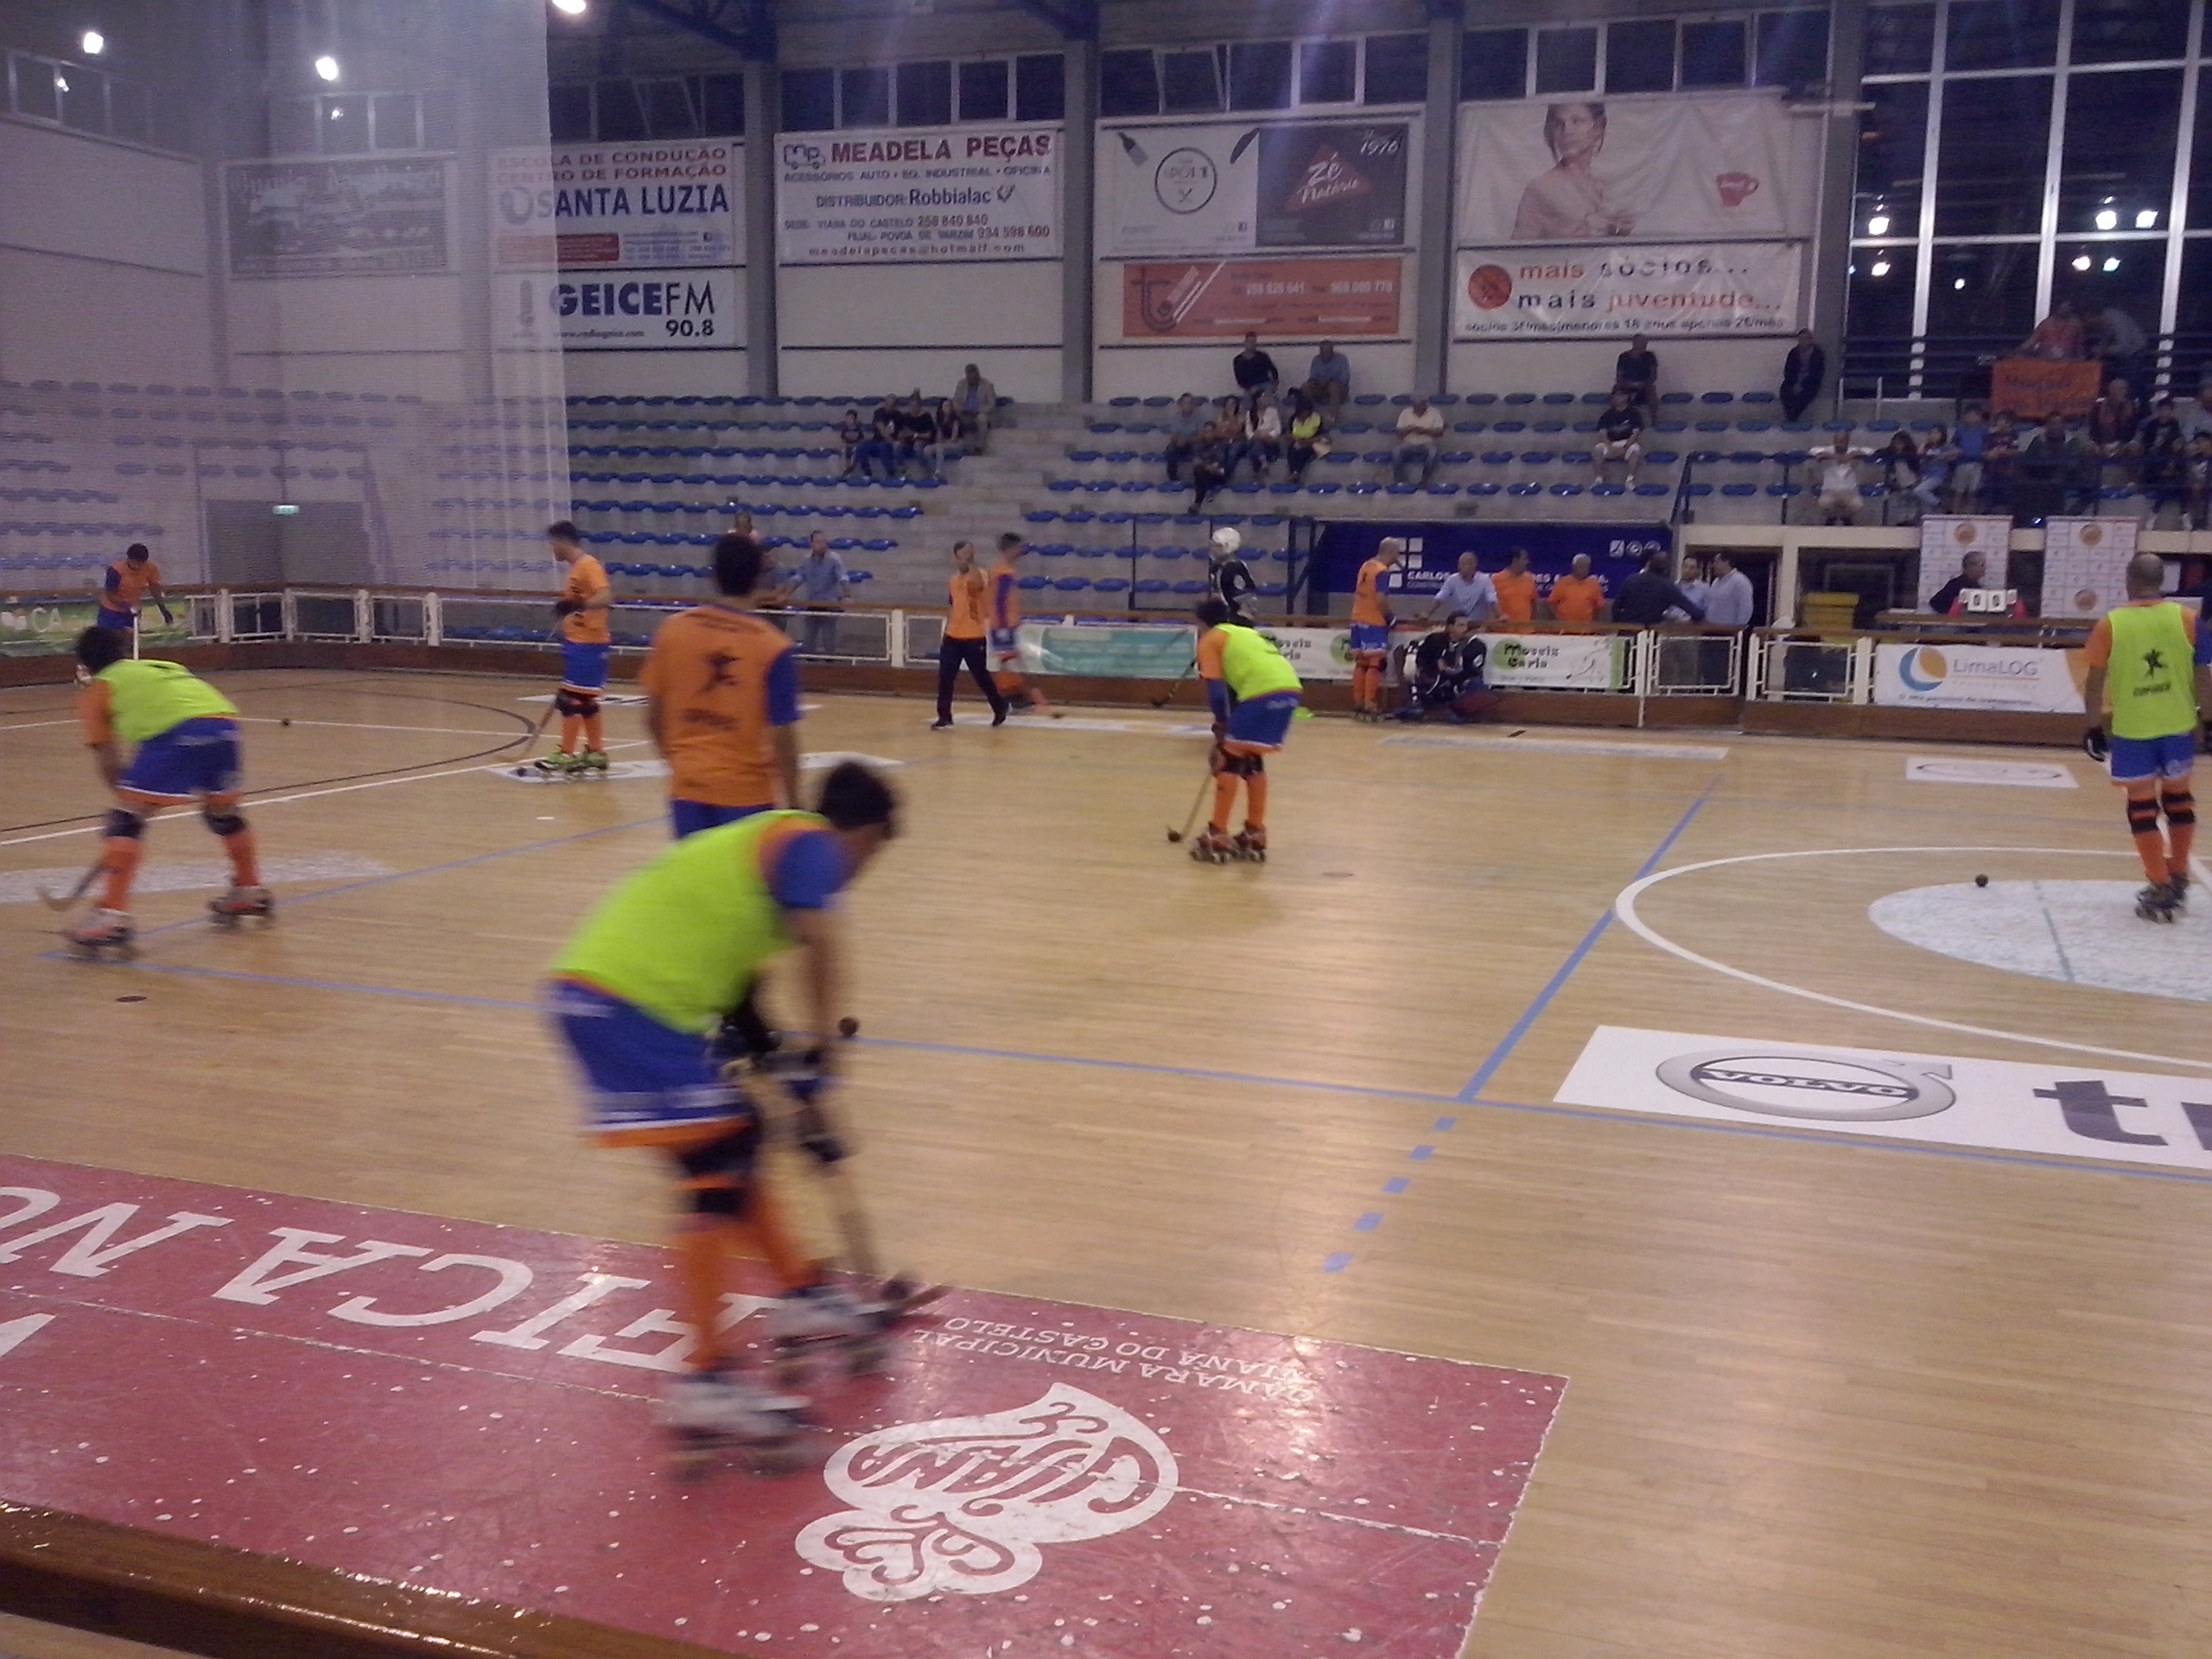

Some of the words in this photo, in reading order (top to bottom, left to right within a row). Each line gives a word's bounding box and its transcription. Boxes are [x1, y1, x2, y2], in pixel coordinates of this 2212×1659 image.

[580, 154, 604, 165] DE
[612, 145, 727, 165] CONDUÇÃO
[830, 139, 952, 164] MEADELA
[965, 135, 1052, 162] PEÇAS
[582, 169, 606, 181] DE
[614, 162, 728, 180] FORMAÇÃO
[536, 187, 631, 217] SANTA
[641, 182, 729, 215] LUZIA
[909, 187, 991, 206] Robbialac
[1519, 261, 1585, 279] mais
[1517, 290, 1596, 309] mais
[664, 318, 715, 338] 90.8
[1954, 658, 2038, 676] LimaLOG
[1704, 1068, 1909, 1096] VOLVO
[2033, 1080, 2212, 1151] t
[944, 1317, 1109, 1352] CASTELO
[912, 1329, 1130, 1376] MUNICIPAL
[1116, 1342, 1171, 1363] DO
[1177, 1350, 1317, 1385] VIANA
